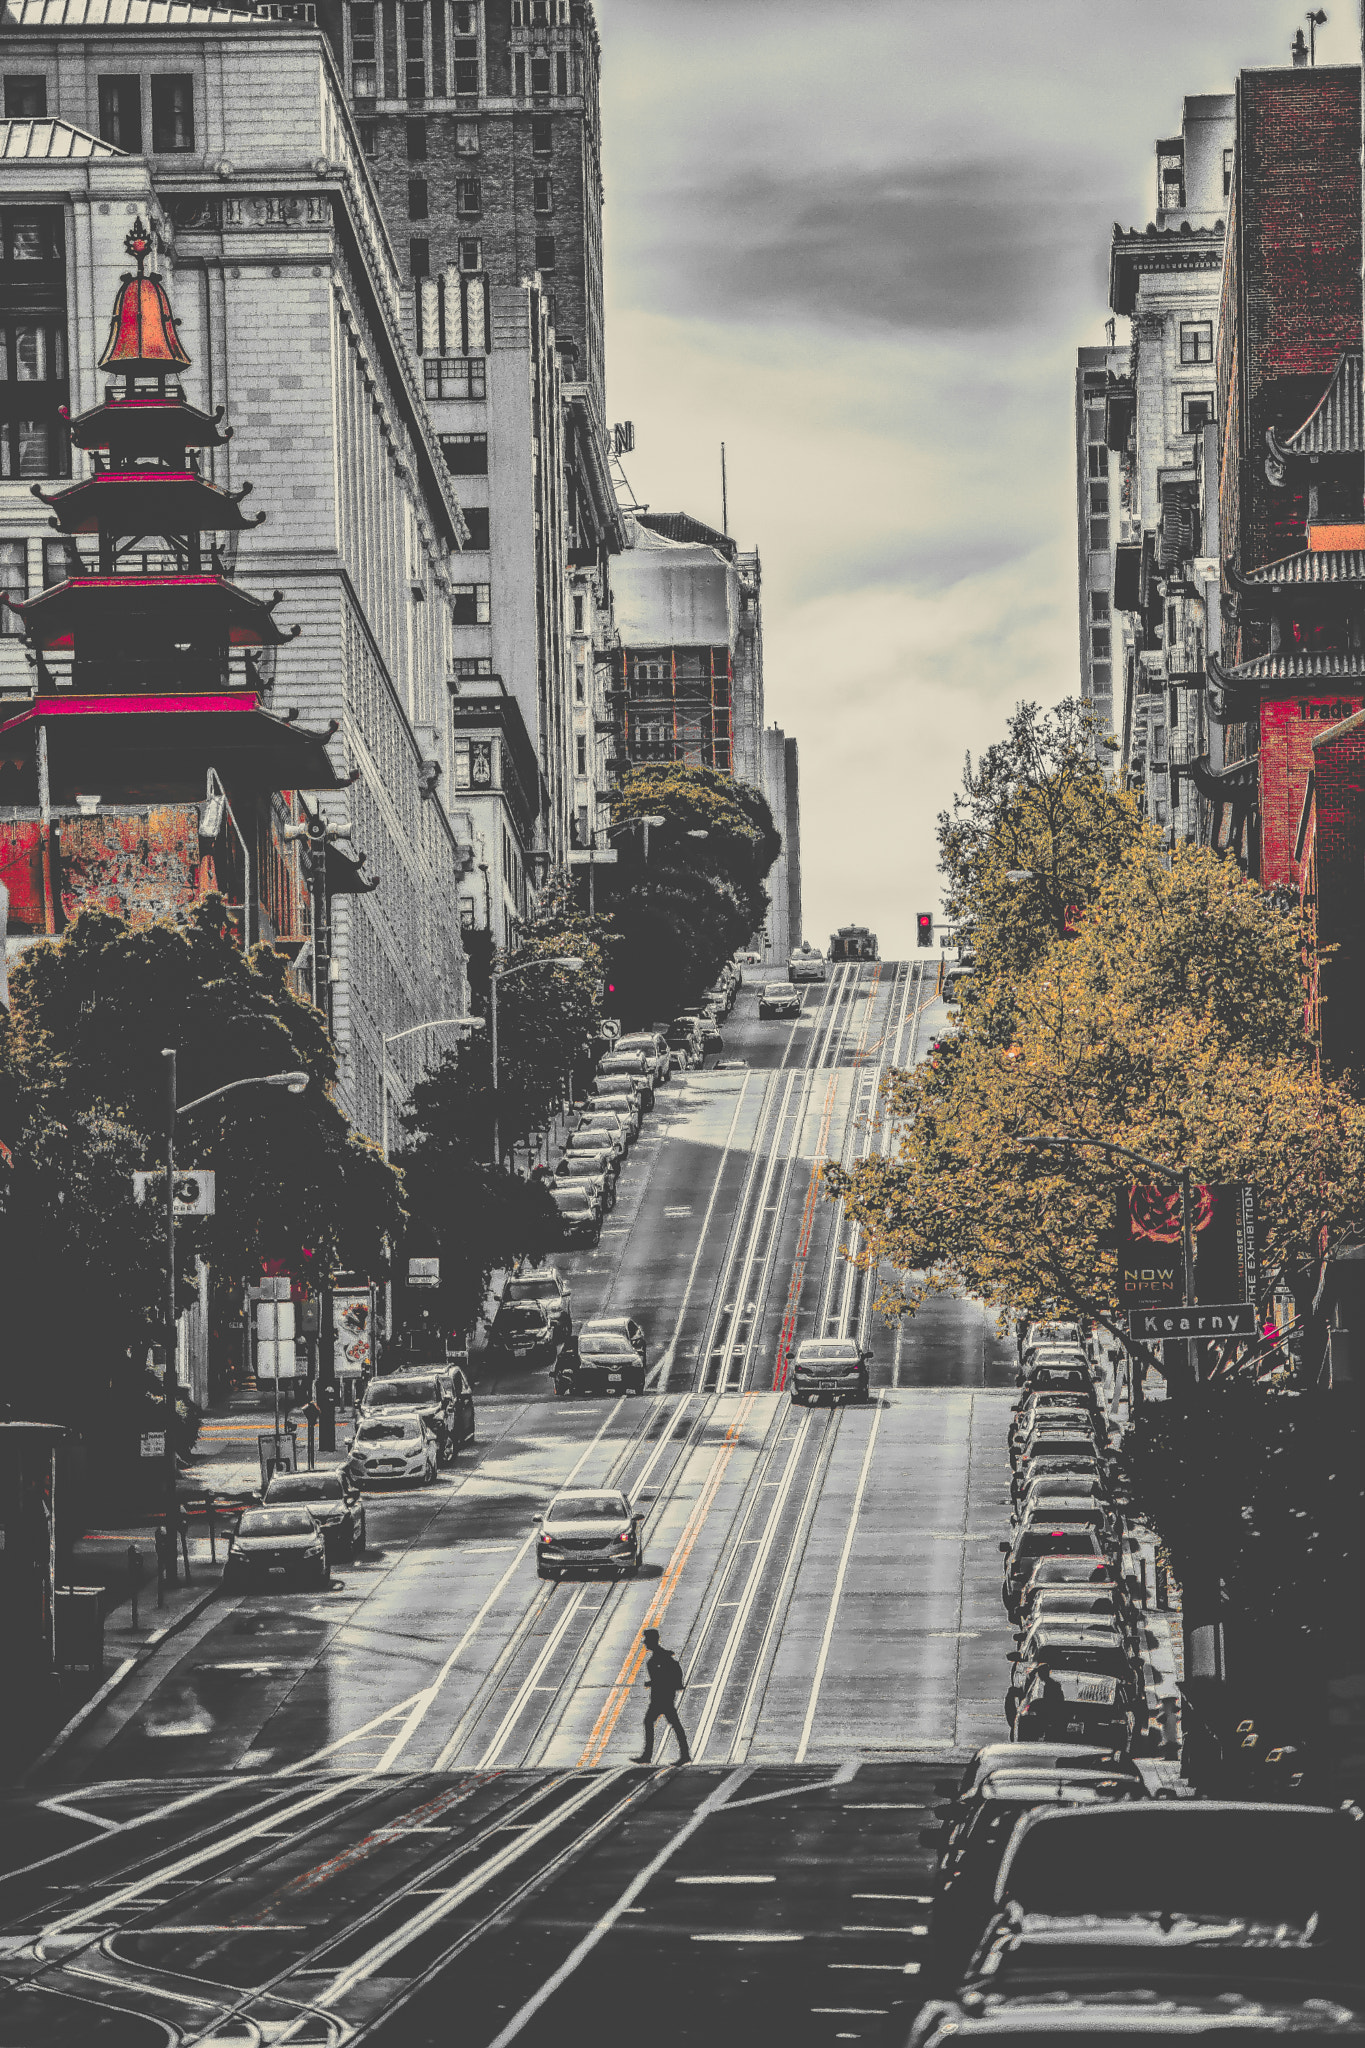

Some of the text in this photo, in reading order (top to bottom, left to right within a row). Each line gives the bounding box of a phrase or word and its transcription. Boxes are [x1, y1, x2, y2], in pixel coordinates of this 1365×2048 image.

[1298, 699, 1353, 720] Trade
[1244, 1186, 1257, 1304] THE EXHIBITION
[1124, 1268, 1174, 1281] NOW
[1124, 1281, 1174, 1291] OPEN
[1144, 1313, 1240, 1332] Kearny
